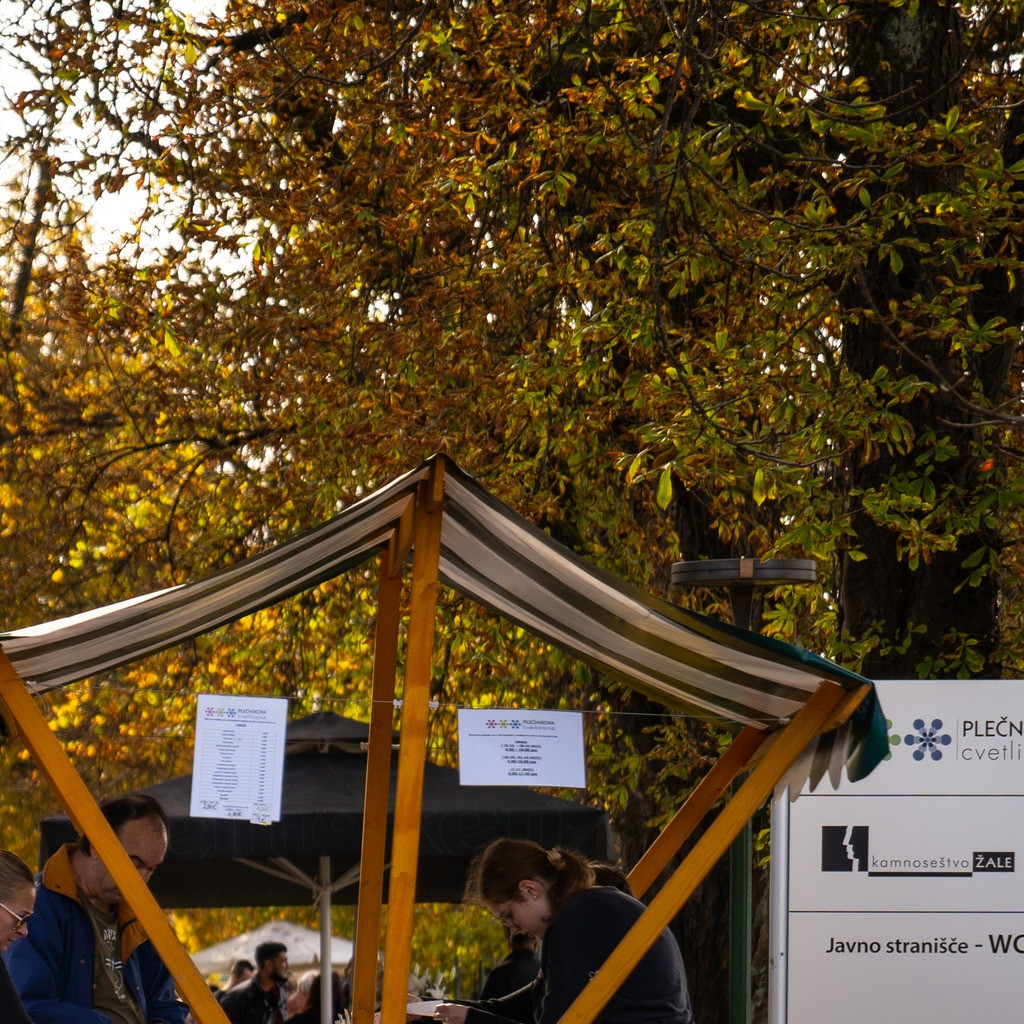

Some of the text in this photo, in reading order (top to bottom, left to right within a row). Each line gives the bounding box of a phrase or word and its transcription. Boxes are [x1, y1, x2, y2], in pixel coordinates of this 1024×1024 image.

[962, 716, 1023, 737] PLEČN
[962, 740, 1021, 760] cvetli
[872, 854, 1012, 868] kamnoseštvo ŽALE
[826, 937, 881, 954] Javno
[886, 938, 968, 954] stranišče
